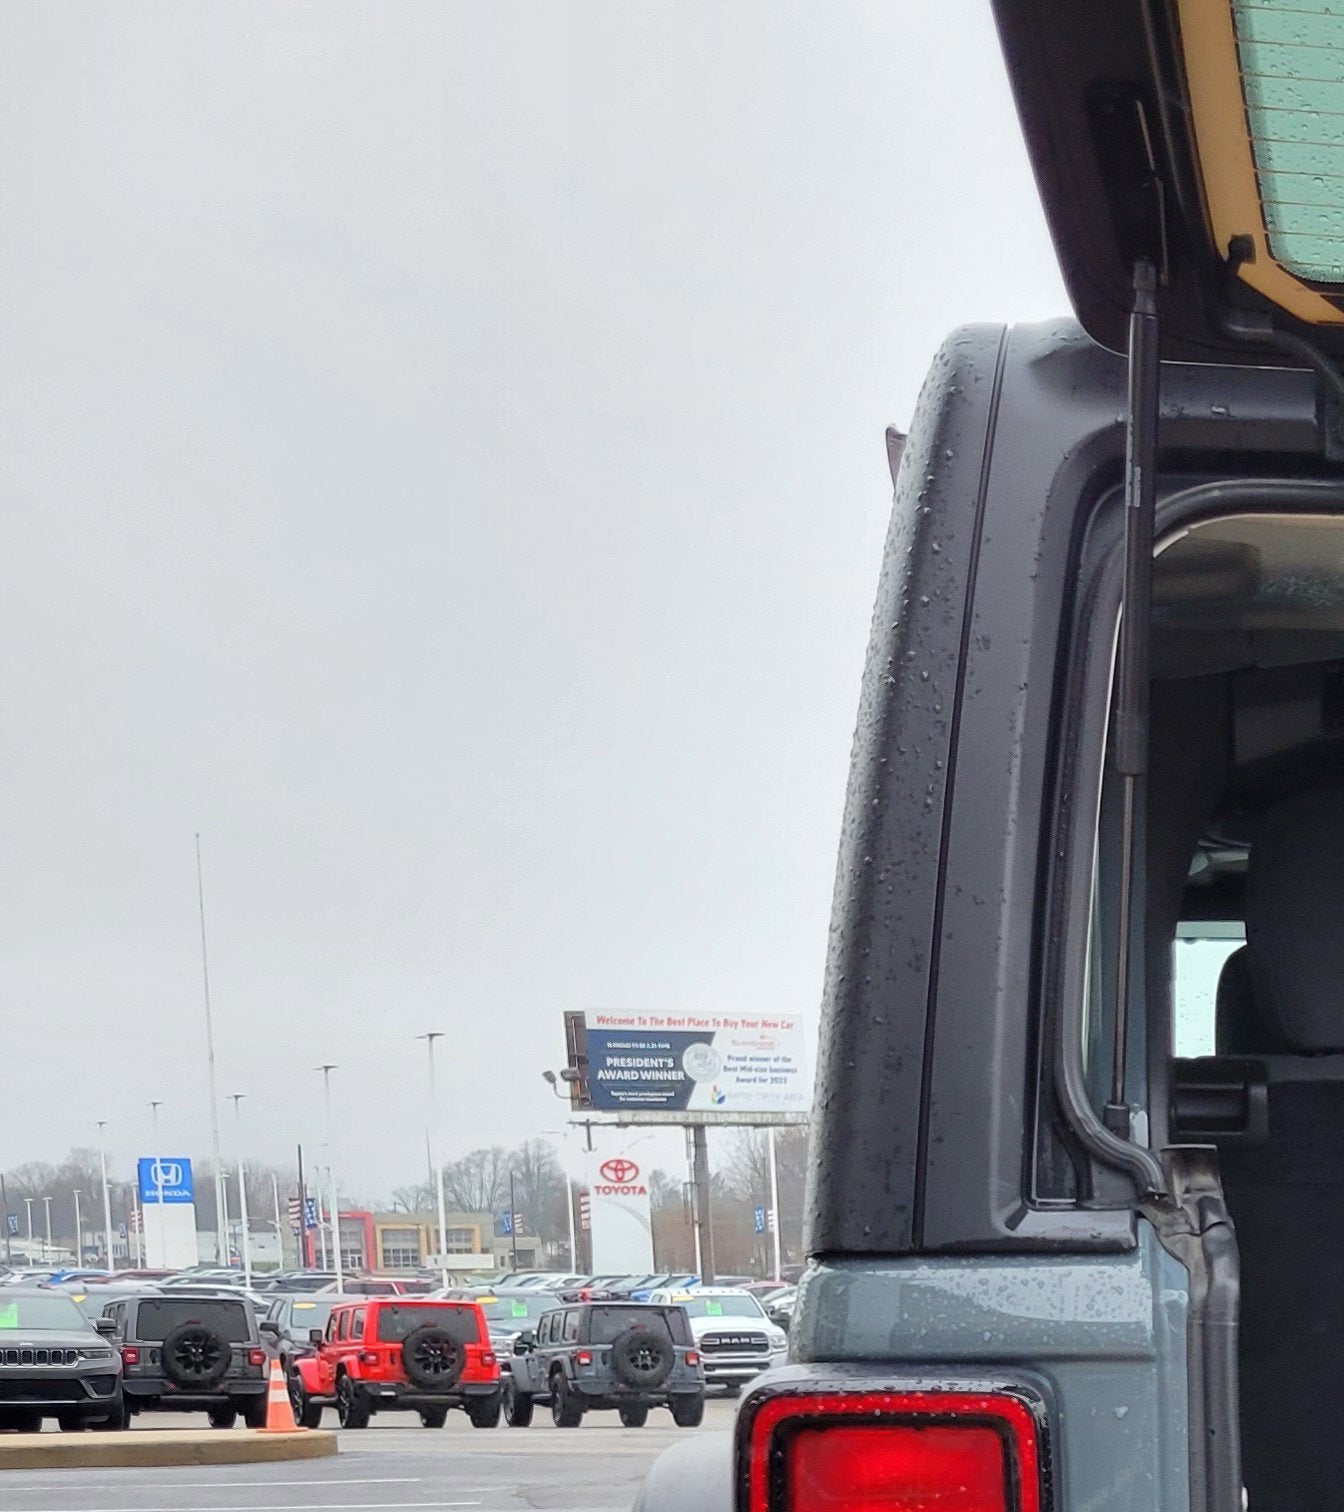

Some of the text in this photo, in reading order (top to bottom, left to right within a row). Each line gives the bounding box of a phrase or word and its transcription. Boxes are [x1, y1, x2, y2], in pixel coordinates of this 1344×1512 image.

[596, 1015, 794, 1030] Welcome To The Best Place To Buy Your New Car
[606, 1057, 675, 1068] PRESIDENT'S
[597, 1070, 686, 1081] AWARD WINNER
[594, 1185, 647, 1196] TOYOTA
